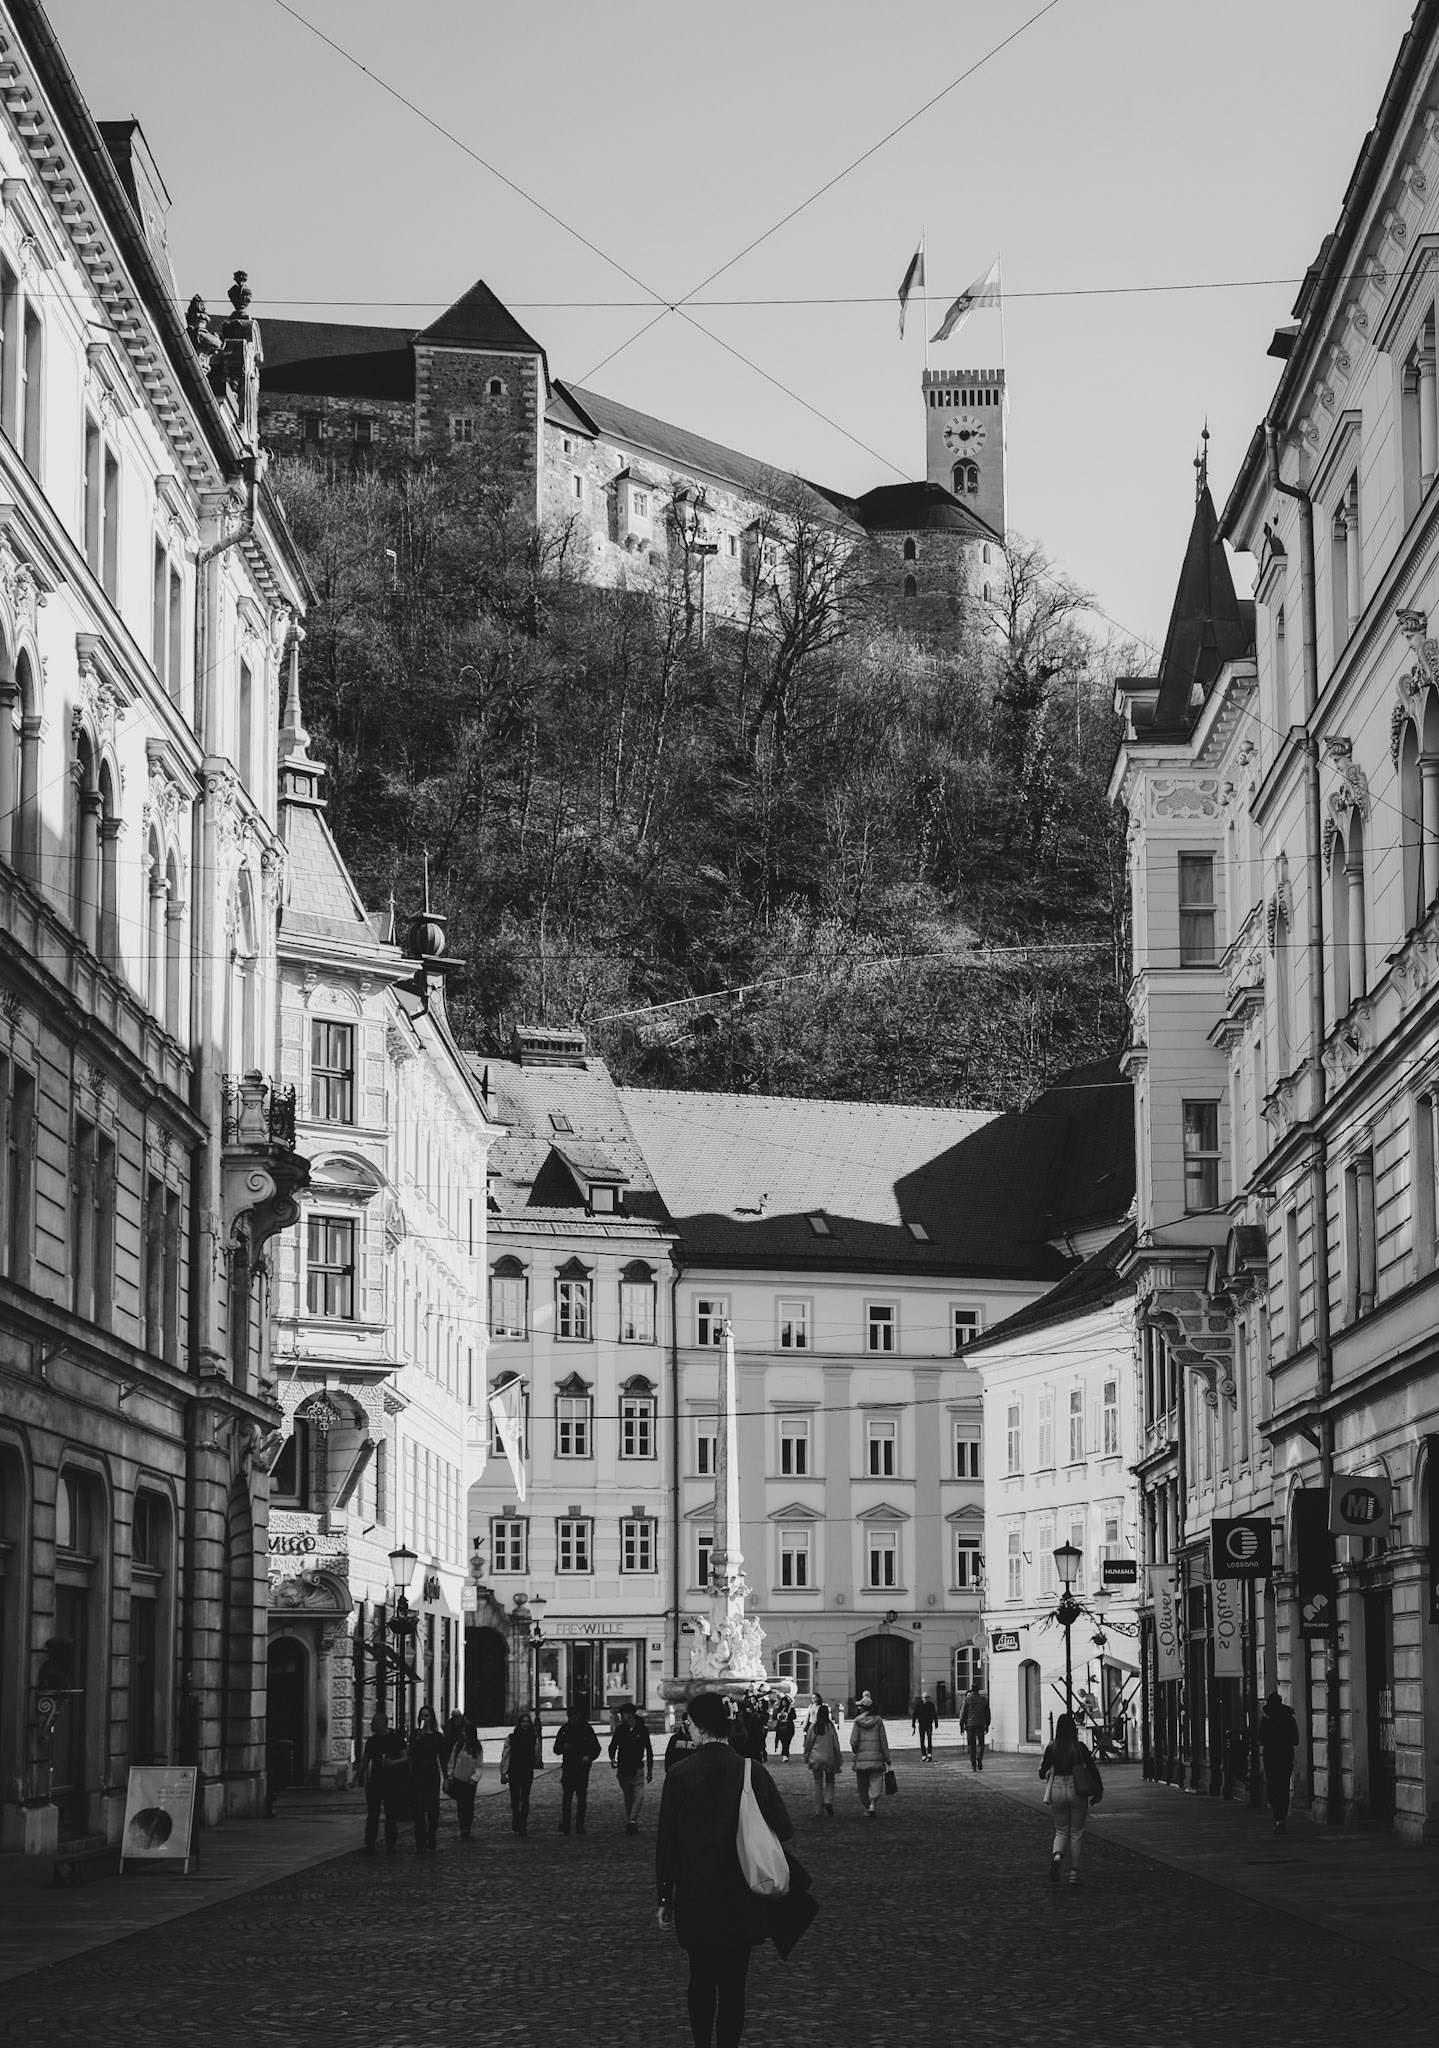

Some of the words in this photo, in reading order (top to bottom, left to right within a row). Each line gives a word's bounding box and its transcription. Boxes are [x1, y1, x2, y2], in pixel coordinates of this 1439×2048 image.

[1159, 1588, 1176, 1656] s.Oliver
[556, 1623, 624, 1635] FREYWILLE
[998, 1634, 1016, 1646] dm
